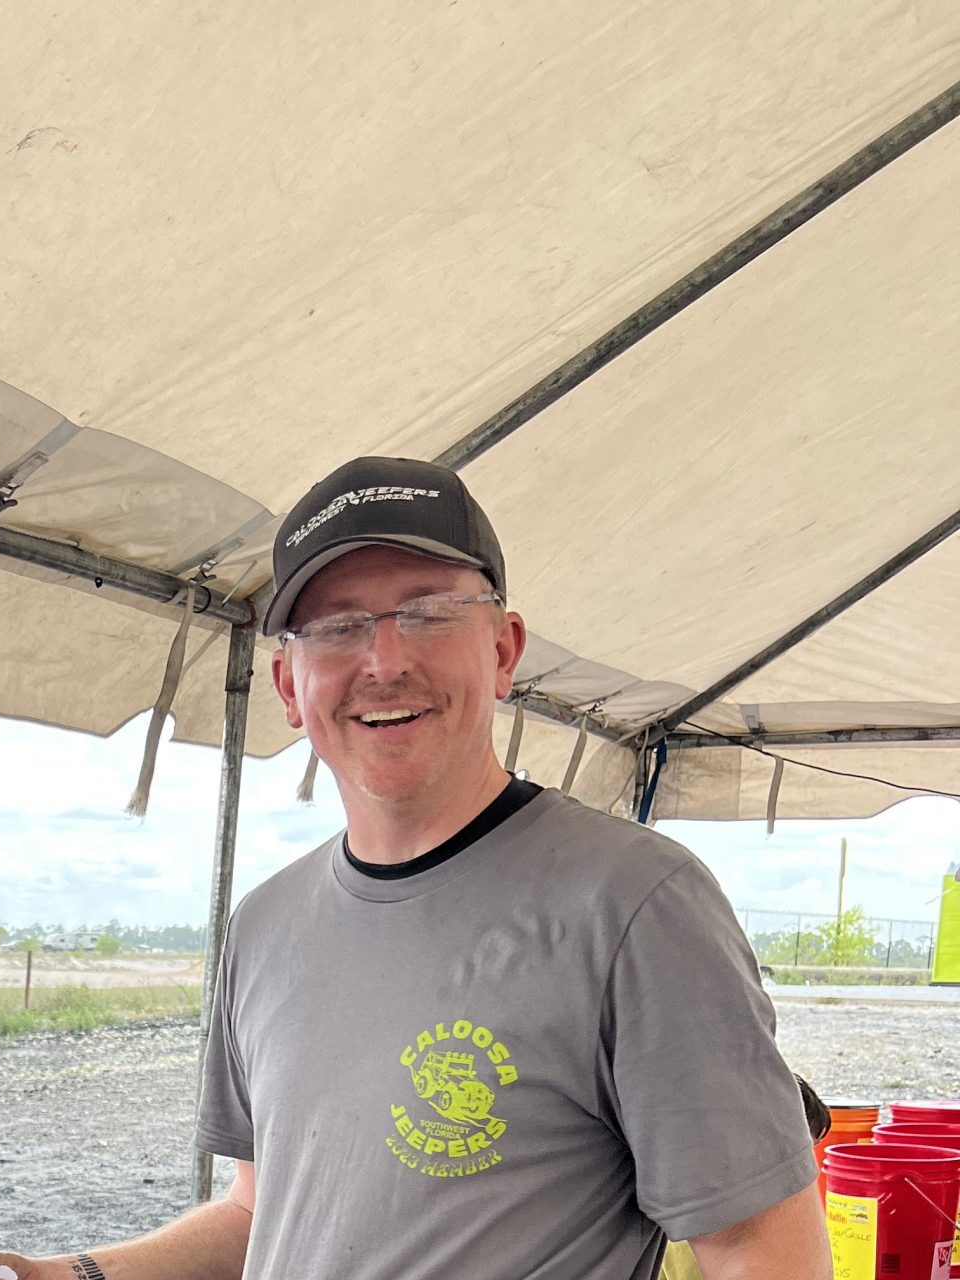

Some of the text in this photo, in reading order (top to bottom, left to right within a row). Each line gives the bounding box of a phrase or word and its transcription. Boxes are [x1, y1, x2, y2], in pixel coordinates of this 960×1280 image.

[286, 486, 440, 547] CALOOSA JEEPERS
[362, 494, 415, 504] FLORIDA
[400, 1019, 518, 1086] CALOOSA
[390, 1103, 508, 1158] JEEPERS
[420, 1119, 471, 1135] SOUTHWEST
[425, 1127, 462, 1140] FLORIDA
